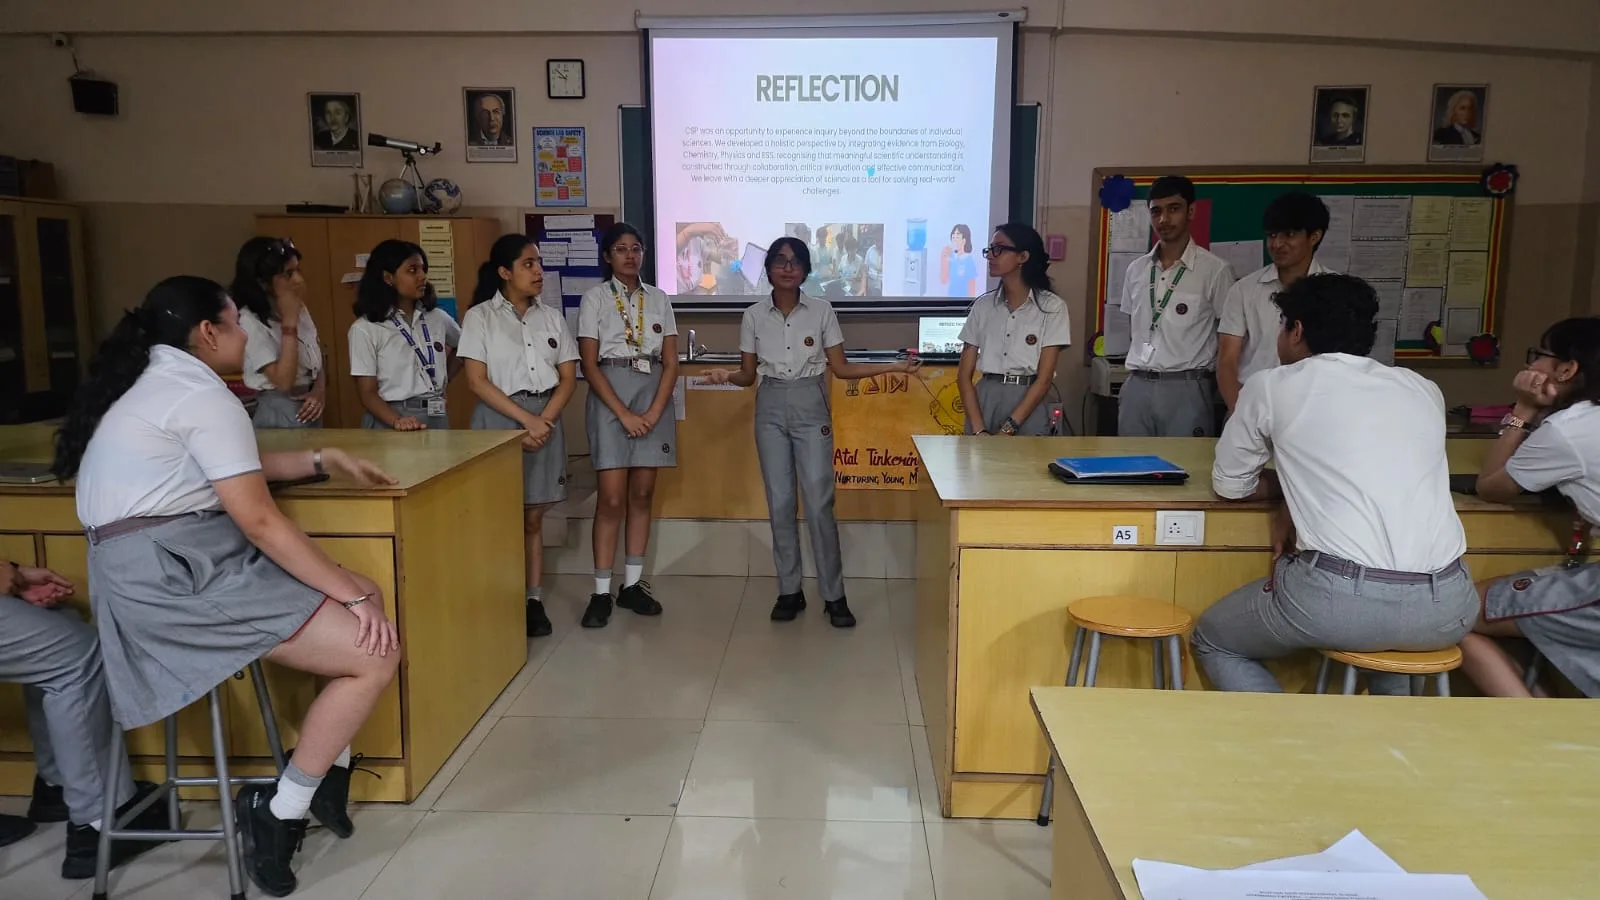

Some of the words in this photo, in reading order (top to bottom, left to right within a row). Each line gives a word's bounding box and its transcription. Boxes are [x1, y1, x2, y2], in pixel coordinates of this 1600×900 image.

[756, 75, 899, 102] REFLECTION
[726, 127, 765, 136] opportunity
[776, 127, 812, 137] experience
[814, 128, 836, 137] inquiry
[839, 128, 864, 137] beyond
[727, 139, 763, 149] developed
[796, 140, 836, 149] perspective
[848, 140, 886, 149] integrating
[721, 151, 745, 161] Physics
[777, 151, 816, 161] recognising
[833, 152, 872, 161] meaningful
[906, 152, 956, 161] understanding
[725, 163, 749, 173] through
[745, 175, 768, 184] deeper
[771, 175, 814, 184] appreciation
[893, 176, 917, 185] solving
[834, 448, 858, 466] Atal
[1115, 530, 1131, 540] A5
